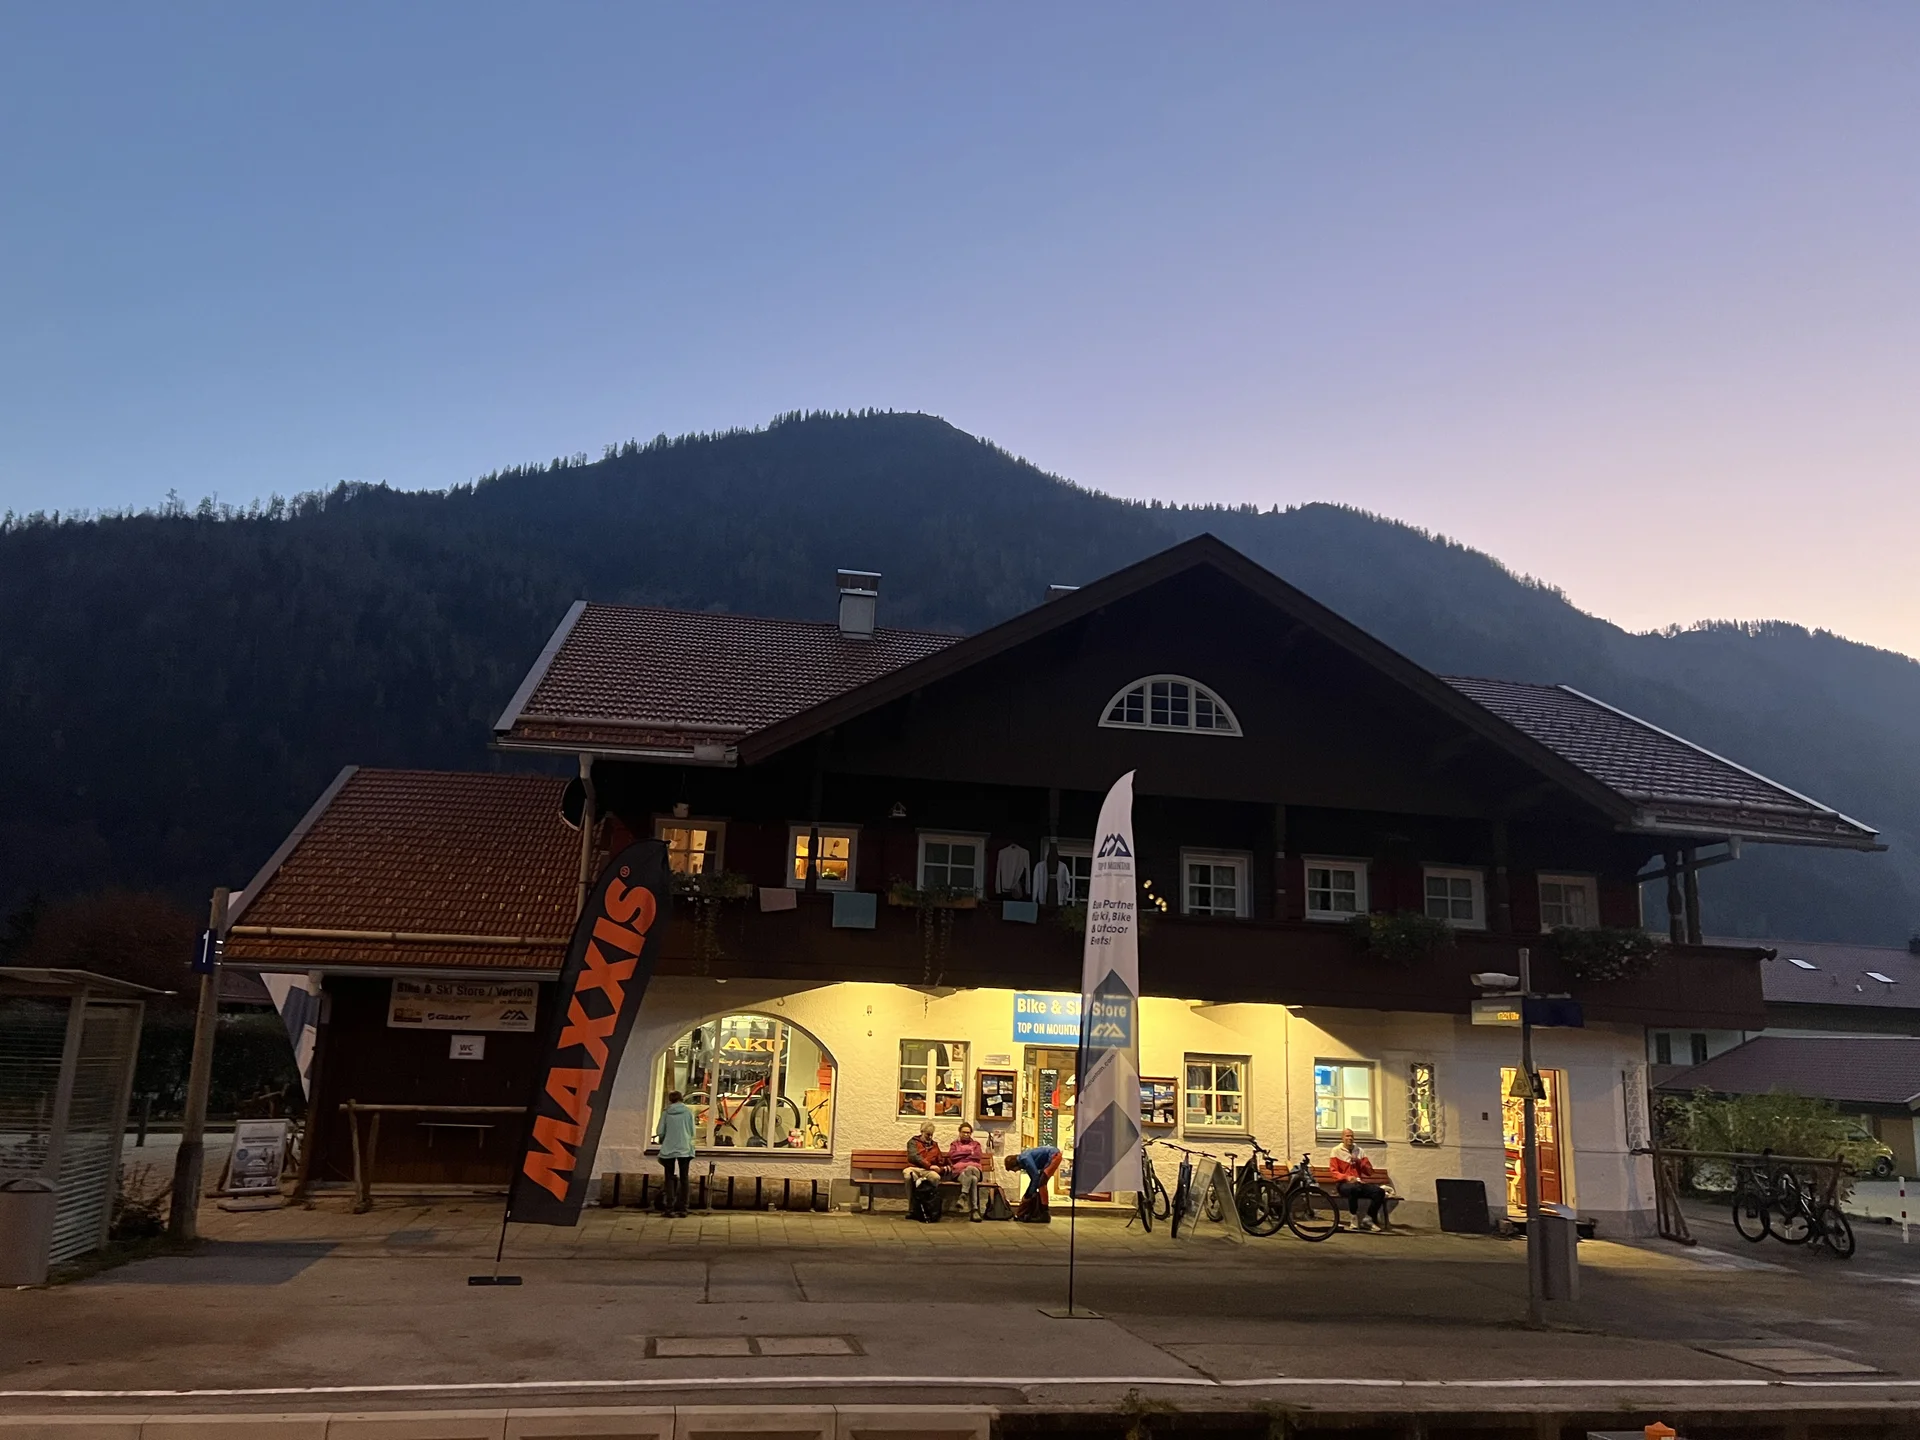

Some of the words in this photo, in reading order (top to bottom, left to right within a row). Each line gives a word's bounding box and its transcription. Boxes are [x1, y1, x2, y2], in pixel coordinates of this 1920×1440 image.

[1103, 900, 1134, 910] Partner
[1112, 912, 1132, 922] Bike
[202, 929, 210, 964] 1
[424, 983, 432, 994] &
[436, 984, 452, 995] Ski
[456, 984, 485, 997] Store
[496, 986, 534, 998] Verleih
[1017, 998, 1047, 1014] Bike
[1051, 999, 1062, 1015] &
[1093, 1002, 1127, 1018] Store
[1017, 1022, 1032, 1034] TOP
[1033, 1023, 1045, 1035] ON
[522, 877, 657, 1203] MAXXIS
[722, 1037, 786, 1053] AKU
